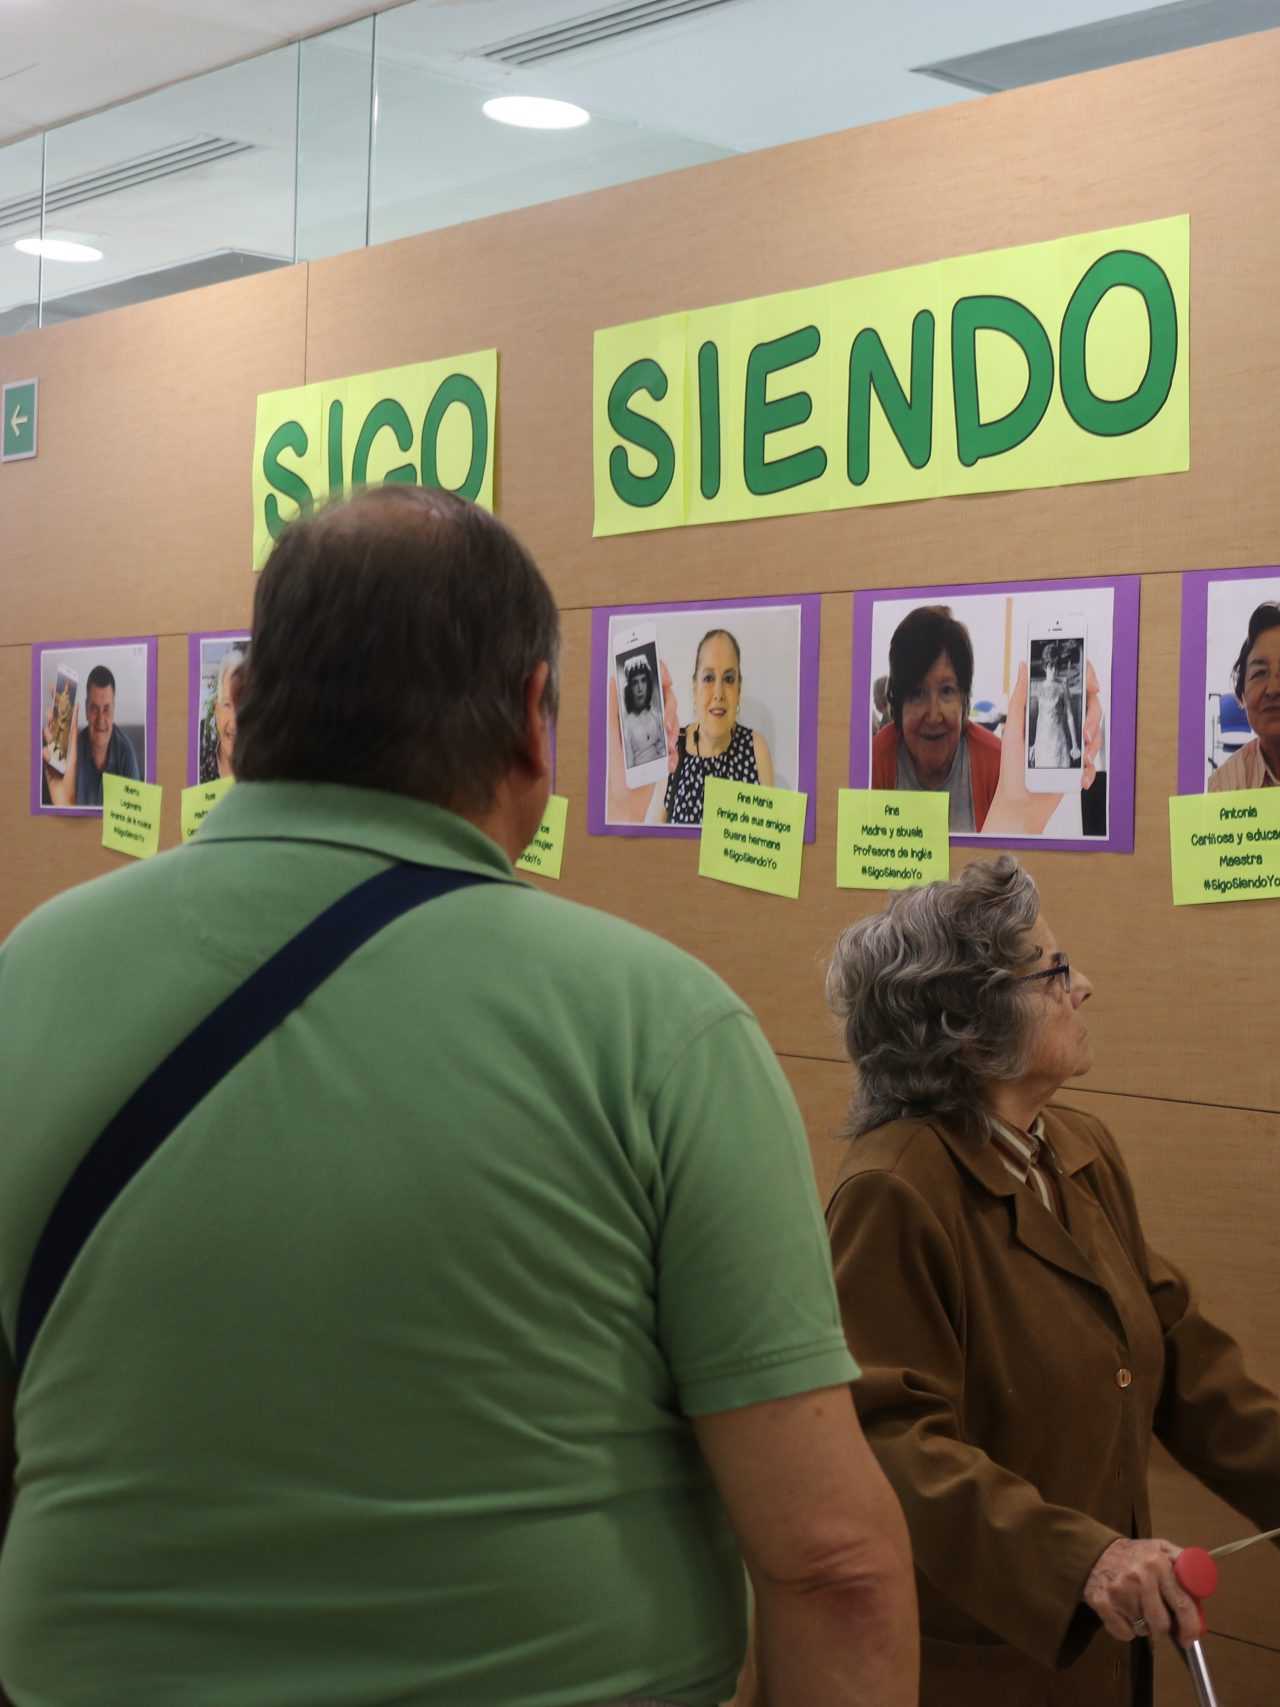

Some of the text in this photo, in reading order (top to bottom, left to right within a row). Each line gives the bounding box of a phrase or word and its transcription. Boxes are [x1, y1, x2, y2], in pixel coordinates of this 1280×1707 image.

[263, 373, 488, 542] SIGO
[607, 249, 1178, 507] SIENDO
[737, 792, 751, 804] Ana
[885, 805, 899, 816] Ana
[1220, 806, 1258, 820] Antonia
[740, 813, 749, 823] de
[766, 819, 791, 833] amigos
[862, 825, 923, 839] Madre y abuela
[1191, 833, 1234, 846] Cariñosa
[1237, 832, 1243, 845] y
[724, 828, 780, 851] Buena hermana
[853, 845, 895, 857] Profesora
[898, 847, 908, 858] de
[724, 848, 777, 870] #SigoSiendoYo
[1220, 854, 1262, 867] Maestra
[862, 865, 922, 880] #SigoSiendoYo
[1204, 875, 1280, 893] #SigoSiendoYo
